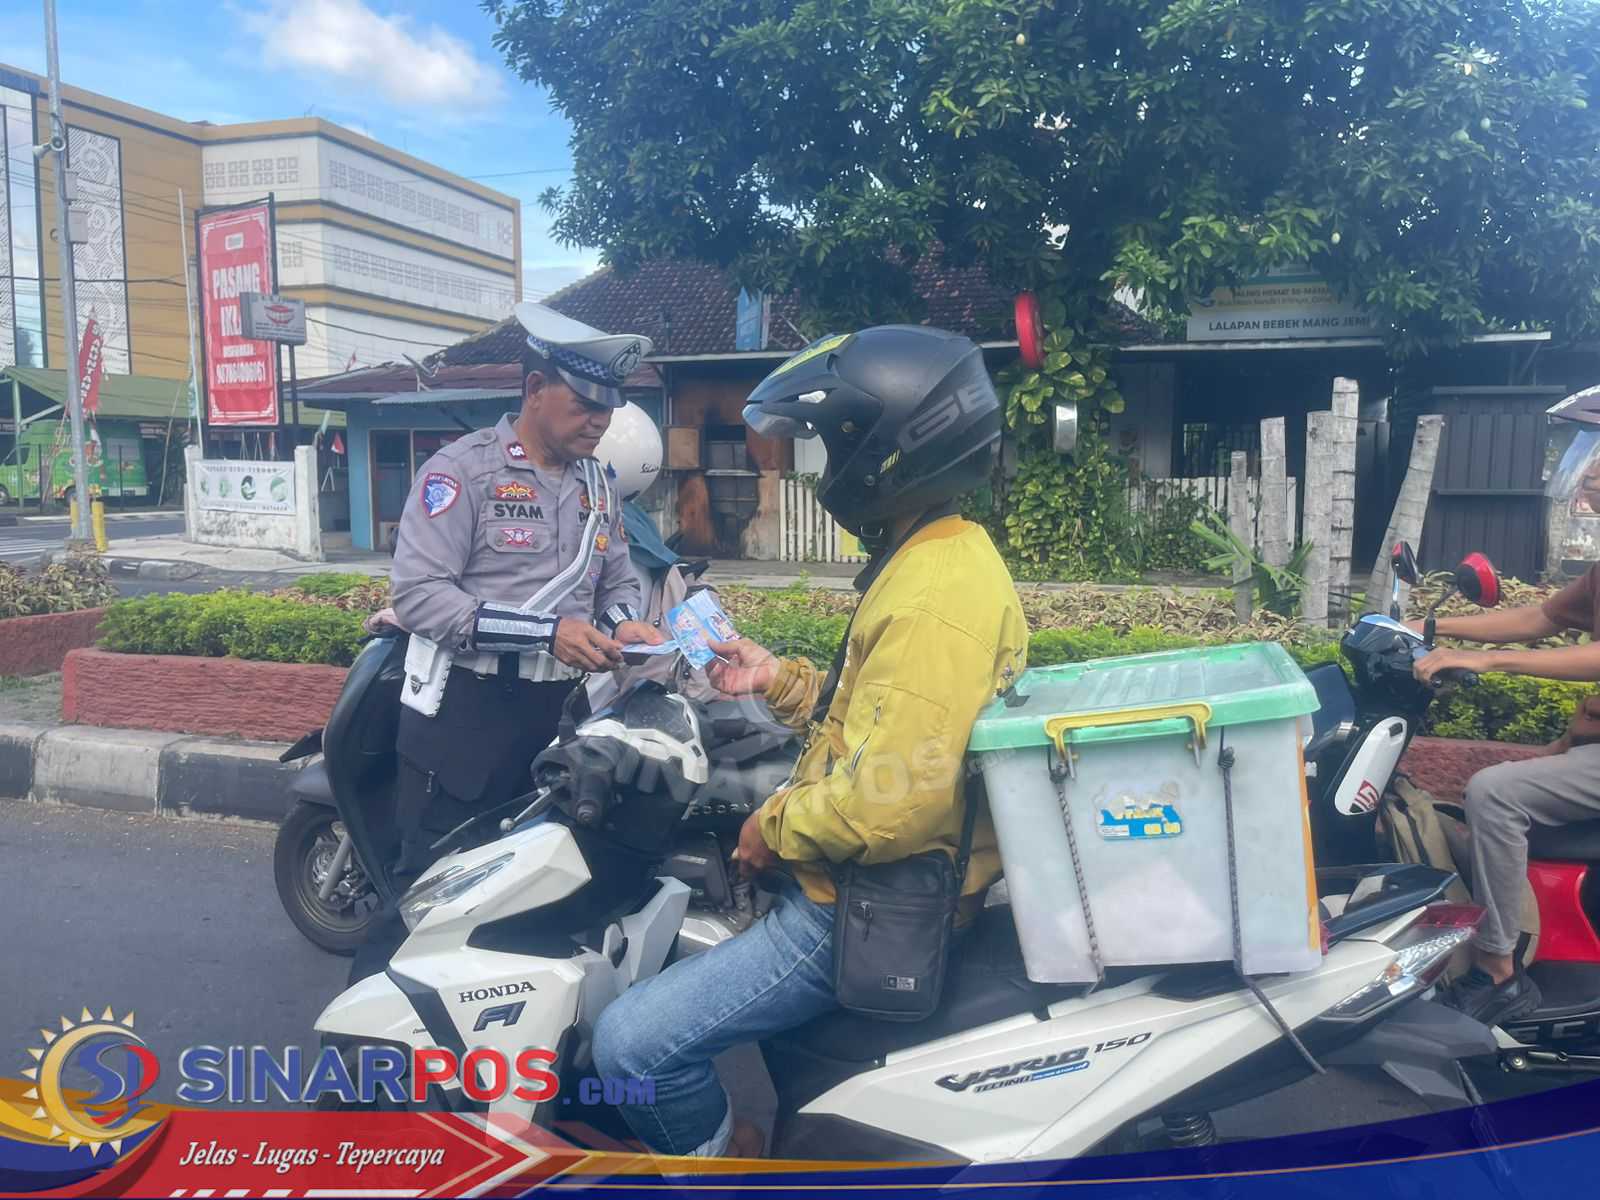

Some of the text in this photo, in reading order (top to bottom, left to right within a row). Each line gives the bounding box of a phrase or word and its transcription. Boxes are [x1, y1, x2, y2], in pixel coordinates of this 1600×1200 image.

[212, 262, 260, 300] PASANG
[1208, 320, 1260, 331] LALAPAN
[1263, 319, 1300, 329] BEBEK
[1302, 316, 1338, 328] MANG
[494, 503, 544, 520] SYAM
[458, 981, 536, 1003] HONDA
[934, 1046, 1089, 1092] VARIO
[1094, 1032, 1152, 1054] 150
[974, 1075, 1031, 1093] TECHNO
